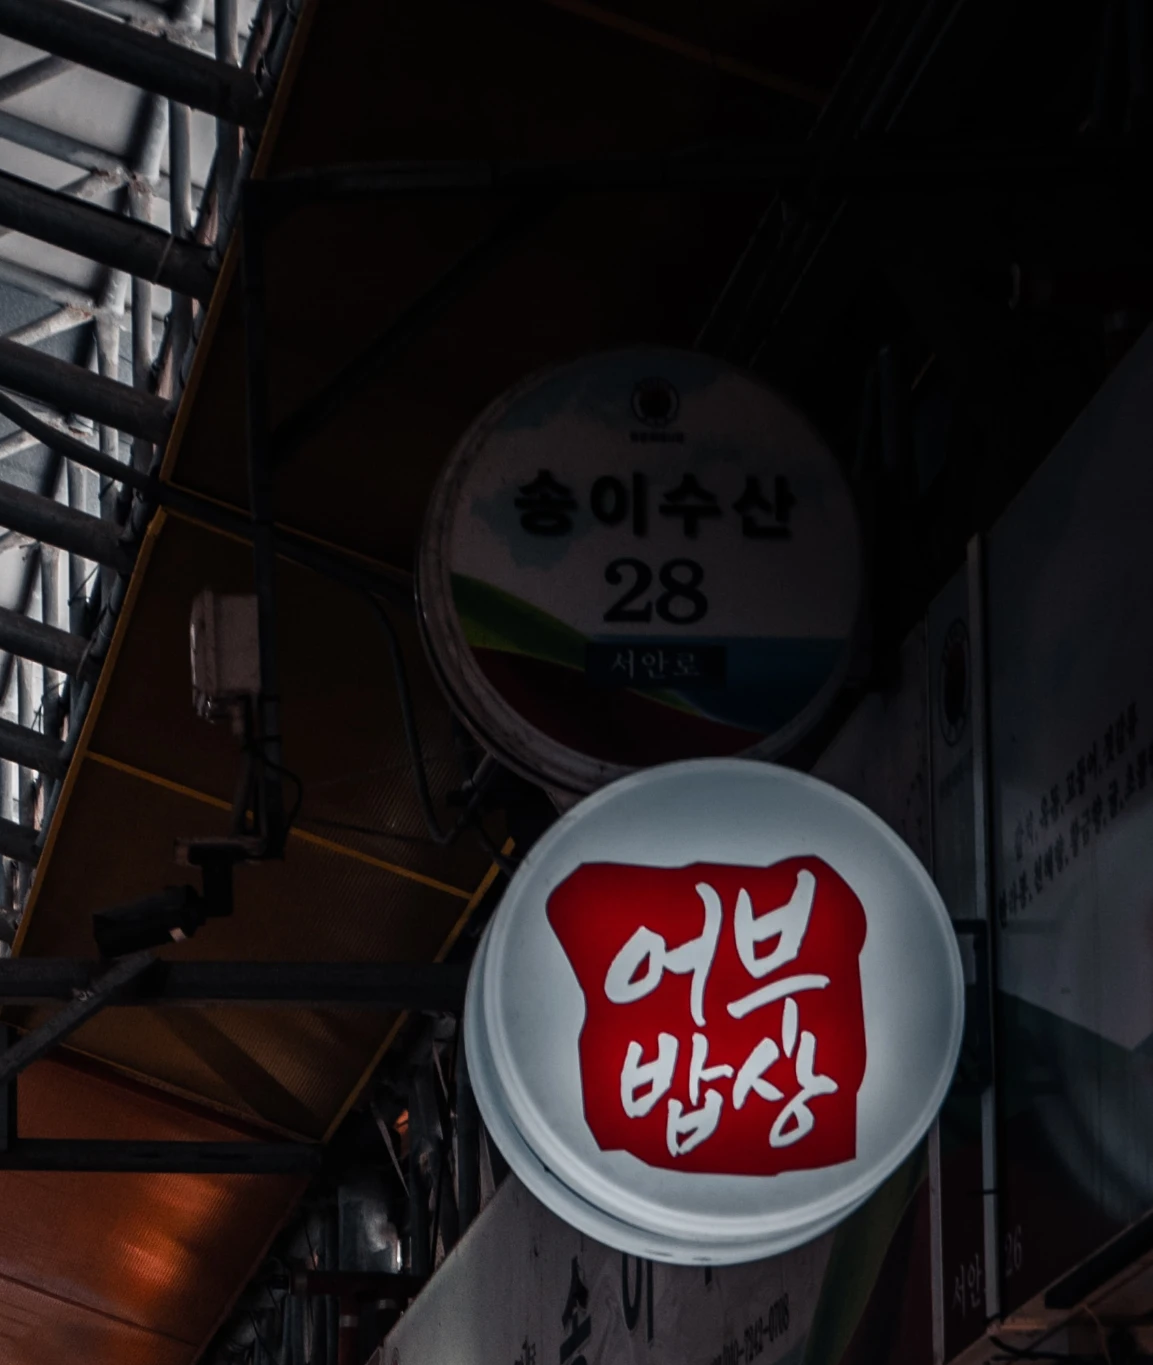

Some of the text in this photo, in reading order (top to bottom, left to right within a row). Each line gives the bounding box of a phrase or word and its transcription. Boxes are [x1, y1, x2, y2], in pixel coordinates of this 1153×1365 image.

[514, 470, 796, 538] 송이수산
[604, 558, 708, 623] 28
[609, 649, 701, 679] 서안로
[604, 868, 830, 1058] 어부
[620, 1030, 838, 1157] 밥상
[951, 1253, 986, 1319] 서안
